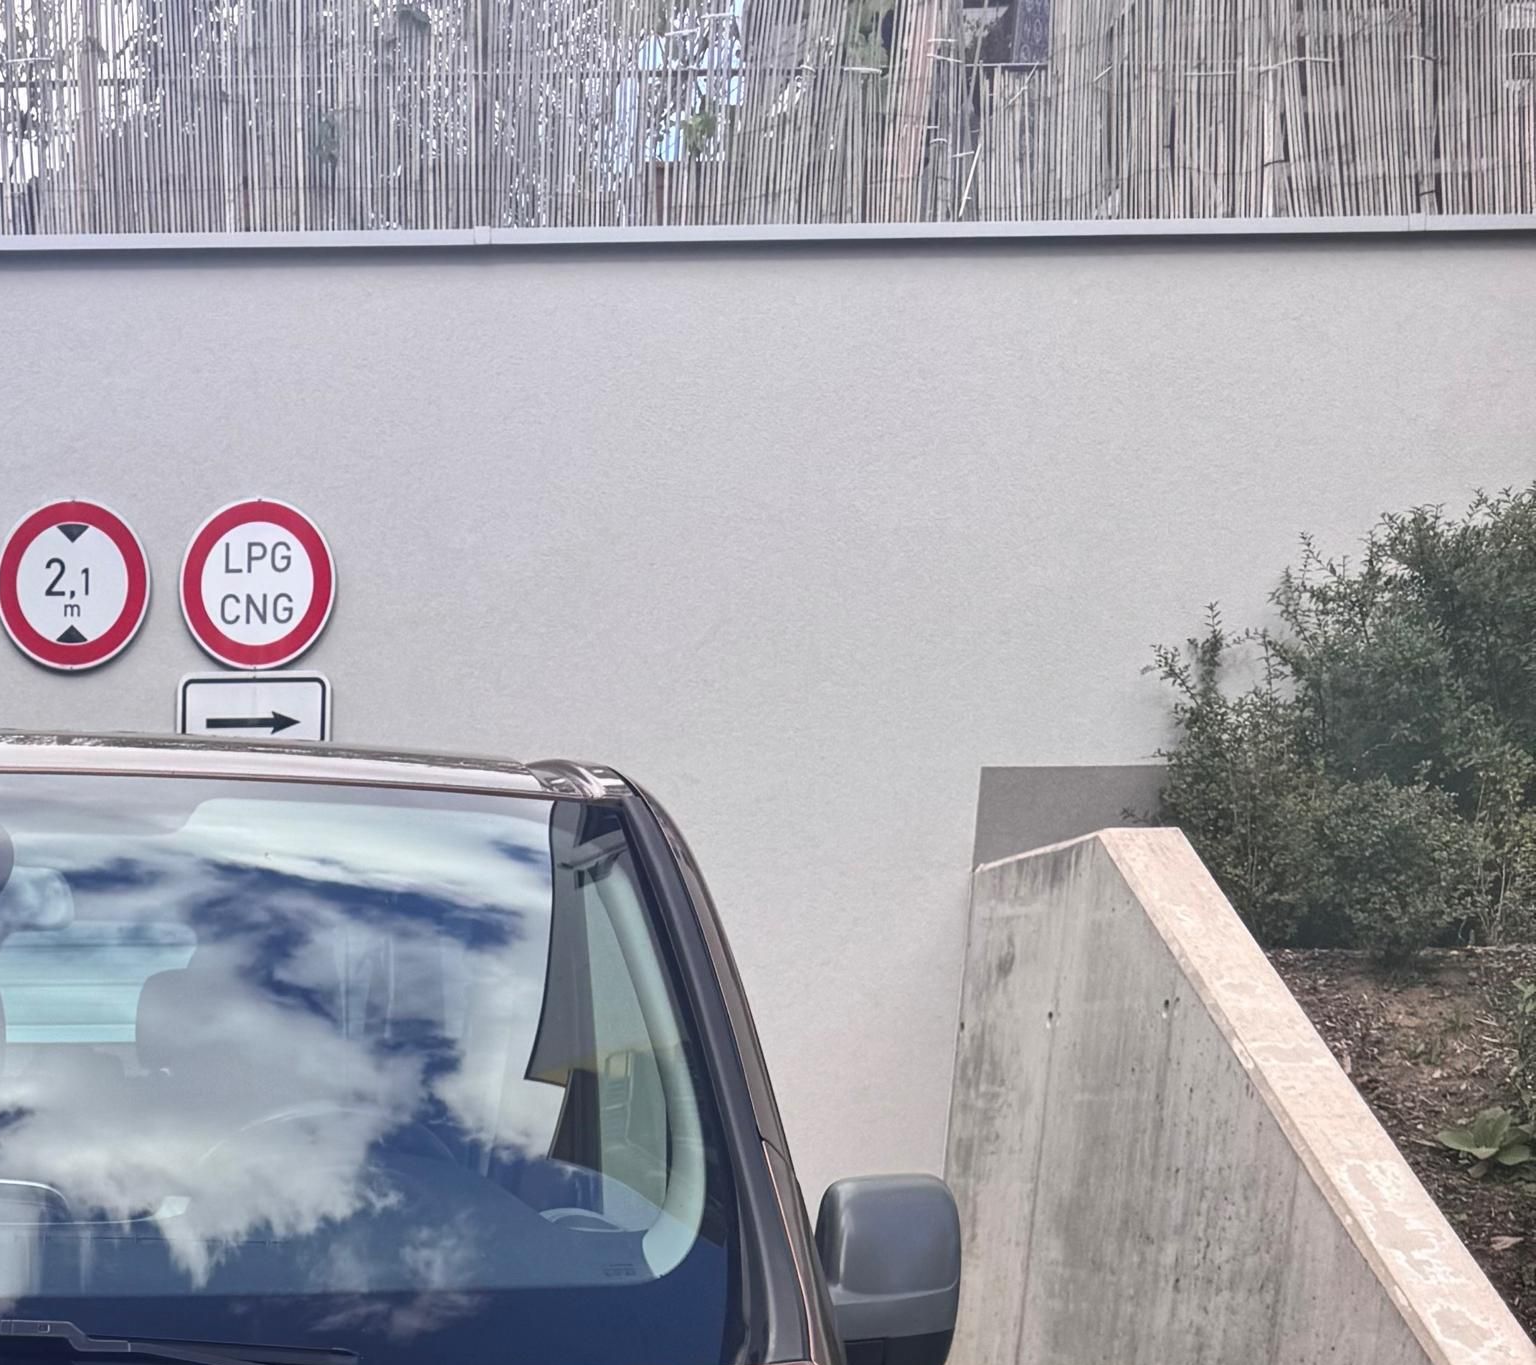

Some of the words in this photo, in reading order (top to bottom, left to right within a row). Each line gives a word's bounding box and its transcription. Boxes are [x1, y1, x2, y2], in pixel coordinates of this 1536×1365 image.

[223, 541, 292, 574] LPG
[44, 557, 90, 600] 2,1
[63, 603, 81, 618] m
[219, 592, 294, 625] CNG
